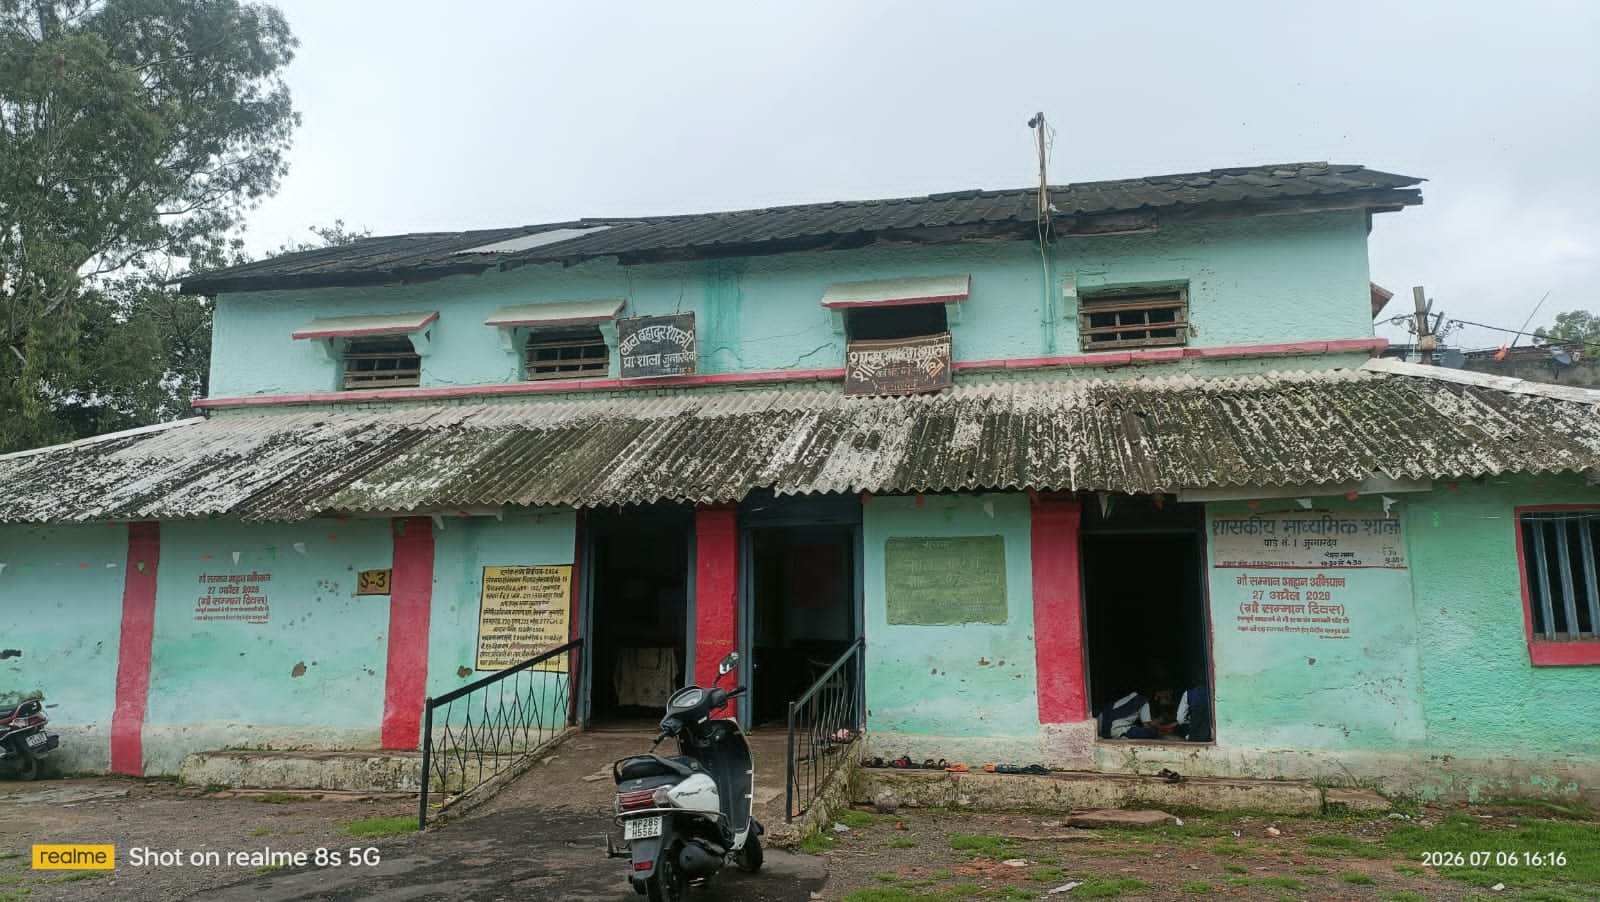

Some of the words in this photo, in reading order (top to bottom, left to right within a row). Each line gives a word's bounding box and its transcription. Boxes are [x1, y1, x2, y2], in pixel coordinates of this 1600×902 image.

[620, 333, 640, 355] लाल
[1212, 516, 1275, 536] शासकीय
[1283, 515, 1357, 535] माध्यमिक
[360, 571, 385, 588] S-3
[1252, 591, 1264, 600] 27
[1262, 604, 1305, 614] सम्मान
